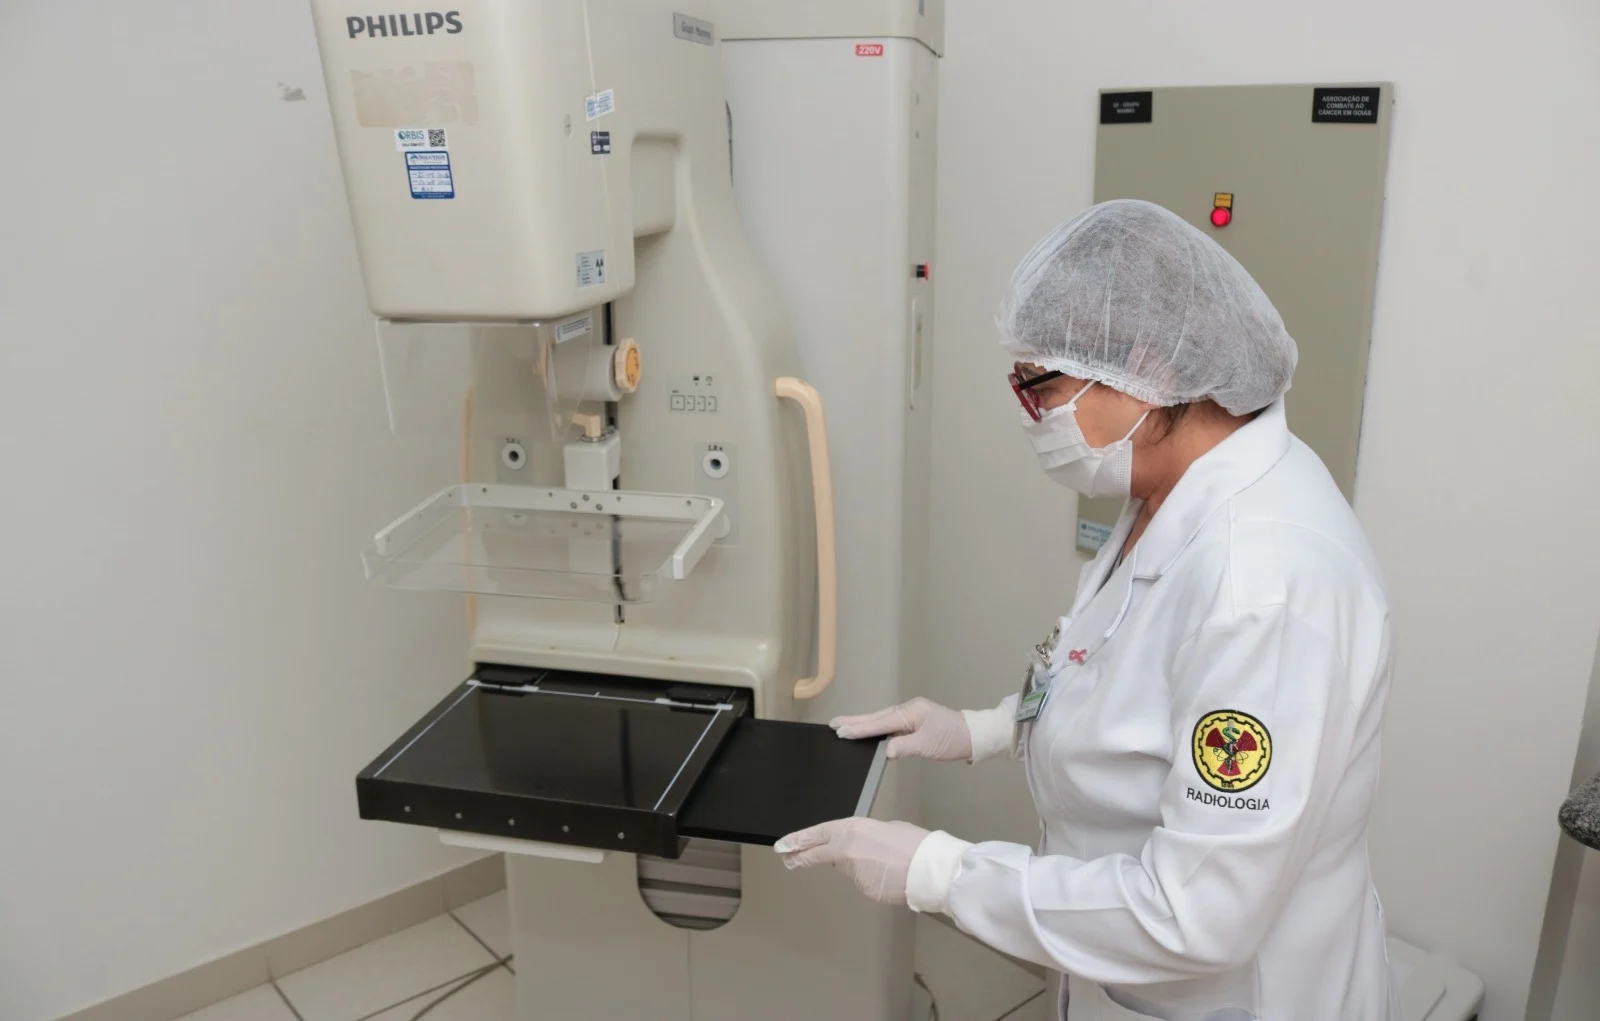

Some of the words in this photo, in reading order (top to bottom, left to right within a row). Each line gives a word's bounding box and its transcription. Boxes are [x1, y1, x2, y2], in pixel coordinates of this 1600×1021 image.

[346, 11, 463, 39] PHILIPS
[859, 46, 882, 55] 220V
[1317, 108, 1342, 116] CÂNCER
[1352, 108, 1372, 116] GOIÁS
[398, 130, 425, 140] ORBIS
[1186, 787, 1270, 811] RADIOLOGIA
